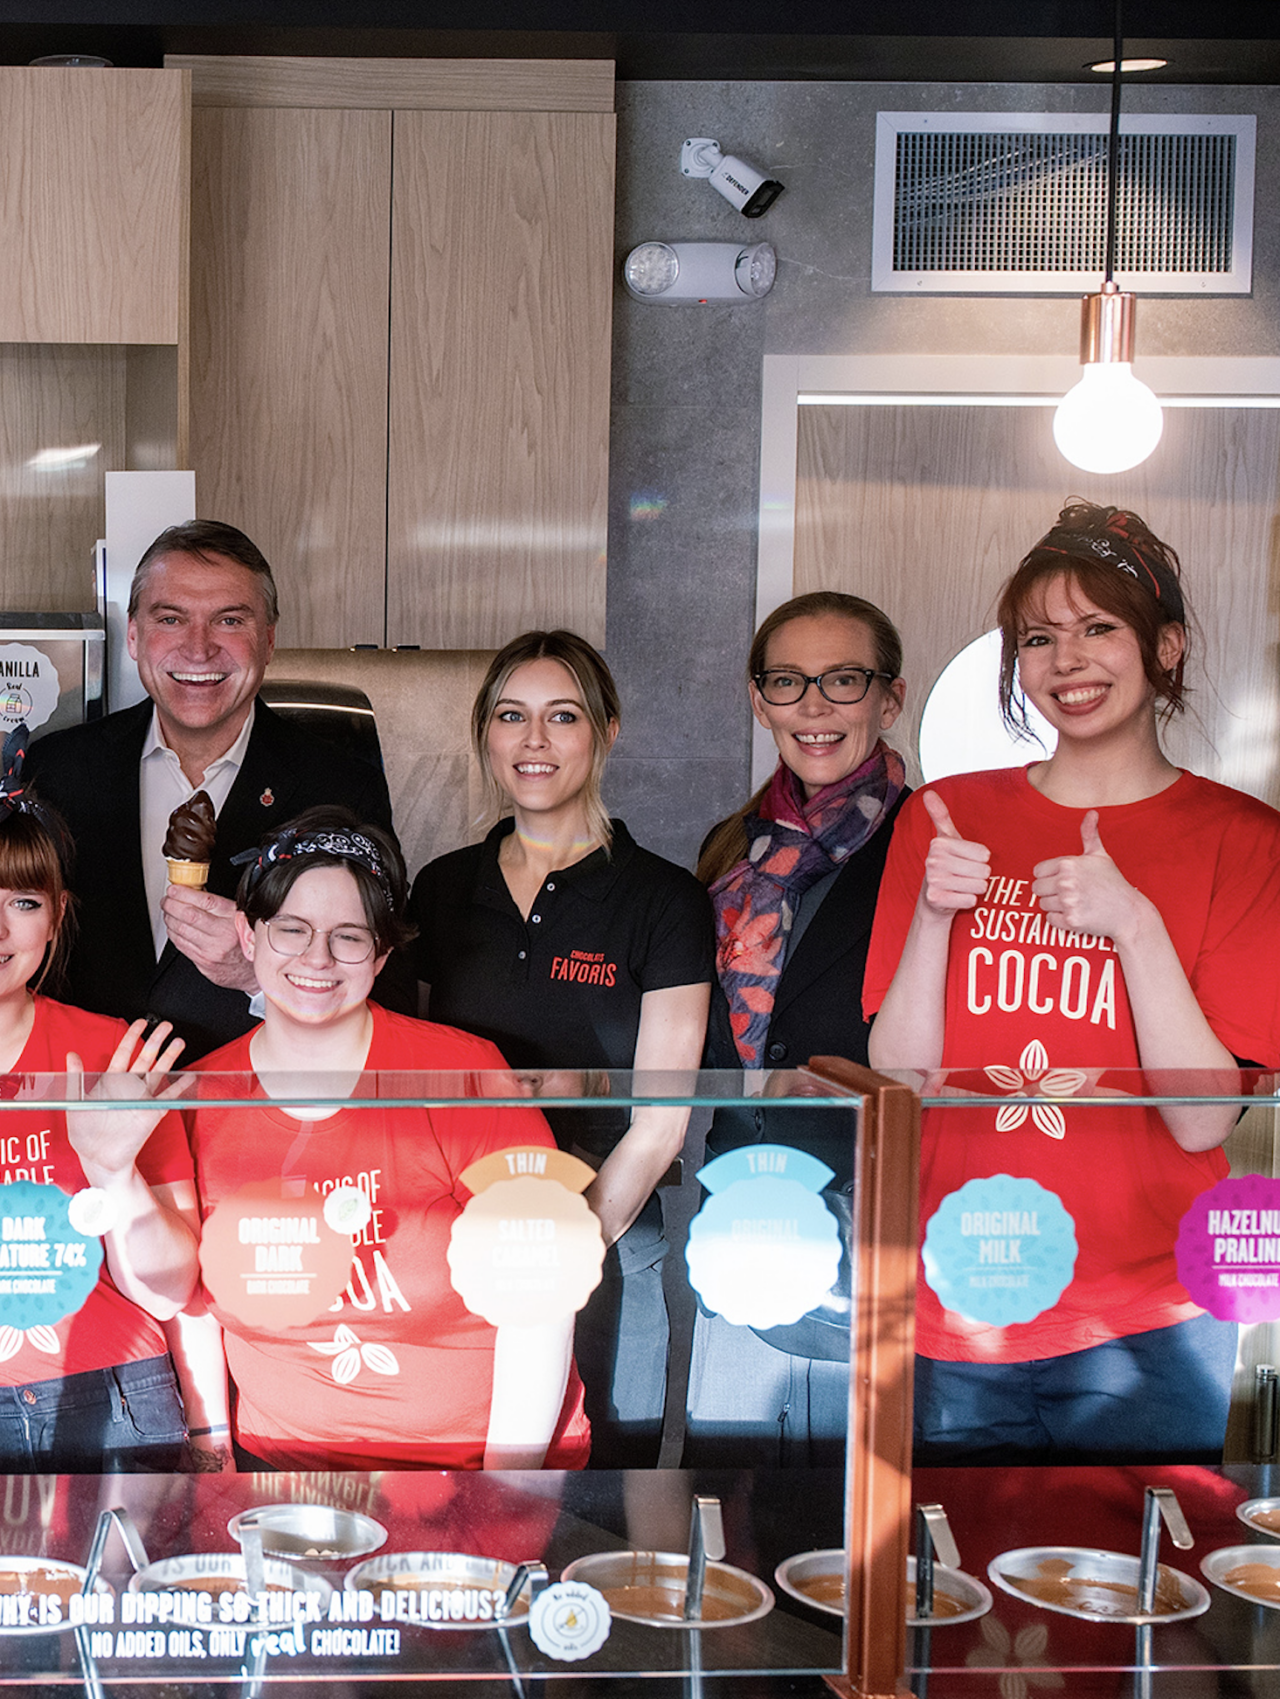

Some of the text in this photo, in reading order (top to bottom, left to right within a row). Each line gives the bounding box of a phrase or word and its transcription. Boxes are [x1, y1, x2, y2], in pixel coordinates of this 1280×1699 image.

[984, 876, 1029, 906] THE
[970, 907, 1118, 953] SUSTAINABL
[549, 956, 617, 988] FAVORIS
[967, 946, 1116, 1031] COCOA
[26, 1129, 51, 1161] OF
[505, 1152, 547, 1175] THIN
[746, 1152, 788, 1173] THIN
[1, 1216, 46, 1241] DARK
[238, 1217, 321, 1244] ORIGINAL
[498, 1218, 556, 1241] SALTED
[731, 1218, 801, 1240] ORIGINAL
[960, 1211, 1041, 1237] ORIGINAL
[1208, 1209, 1280, 1235] HAZELNU
[54, 1243, 87, 1267] 74%
[255, 1245, 304, 1272] DARK
[978, 1239, 1022, 1264] MILK
[1214, 1237, 1280, 1263] PRALIN
[12, 1279, 56, 1295] CHOCOLATE
[38, 1593, 62, 1625] IS
[69, 1592, 115, 1624] OUR
[121, 1591, 213, 1624] DIPPING
[219, 1590, 251, 1623] SO
[254, 1590, 322, 1623] THICK
[328, 1590, 374, 1622] AND
[380, 1589, 508, 1622] DELICIOUS?
[91, 1622, 401, 1659] NO ADDED OILS, ONLY real CHOCOLATE!
